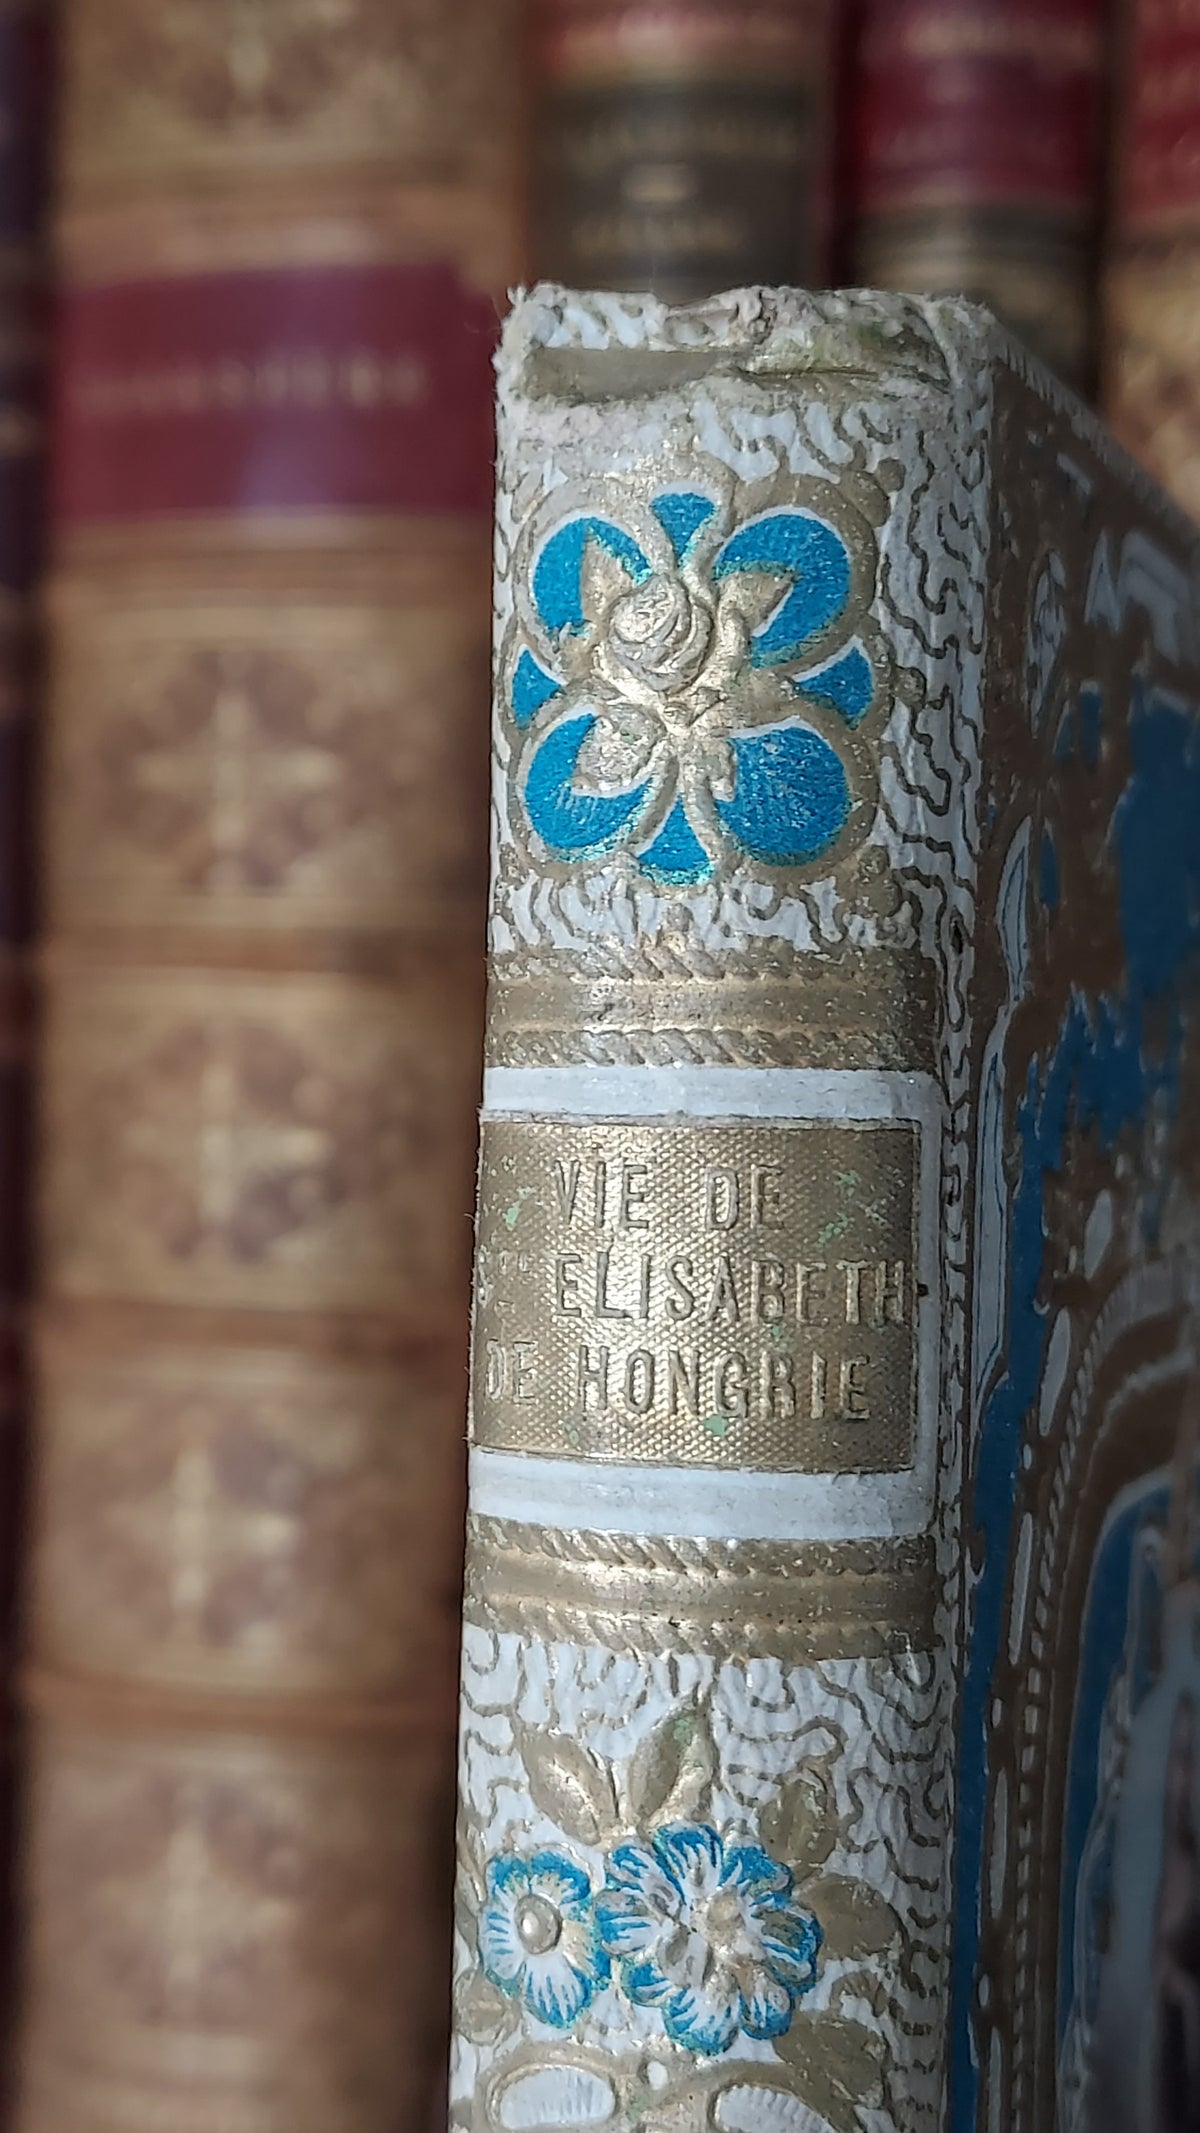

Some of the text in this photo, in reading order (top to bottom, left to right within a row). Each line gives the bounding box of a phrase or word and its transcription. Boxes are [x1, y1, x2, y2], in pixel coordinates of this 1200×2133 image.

[554, 1158, 785, 1232] VIE DE
[553, 1250, 905, 1328] ELISABETH
[486, 1338, 871, 1421] DE HONGRIE
